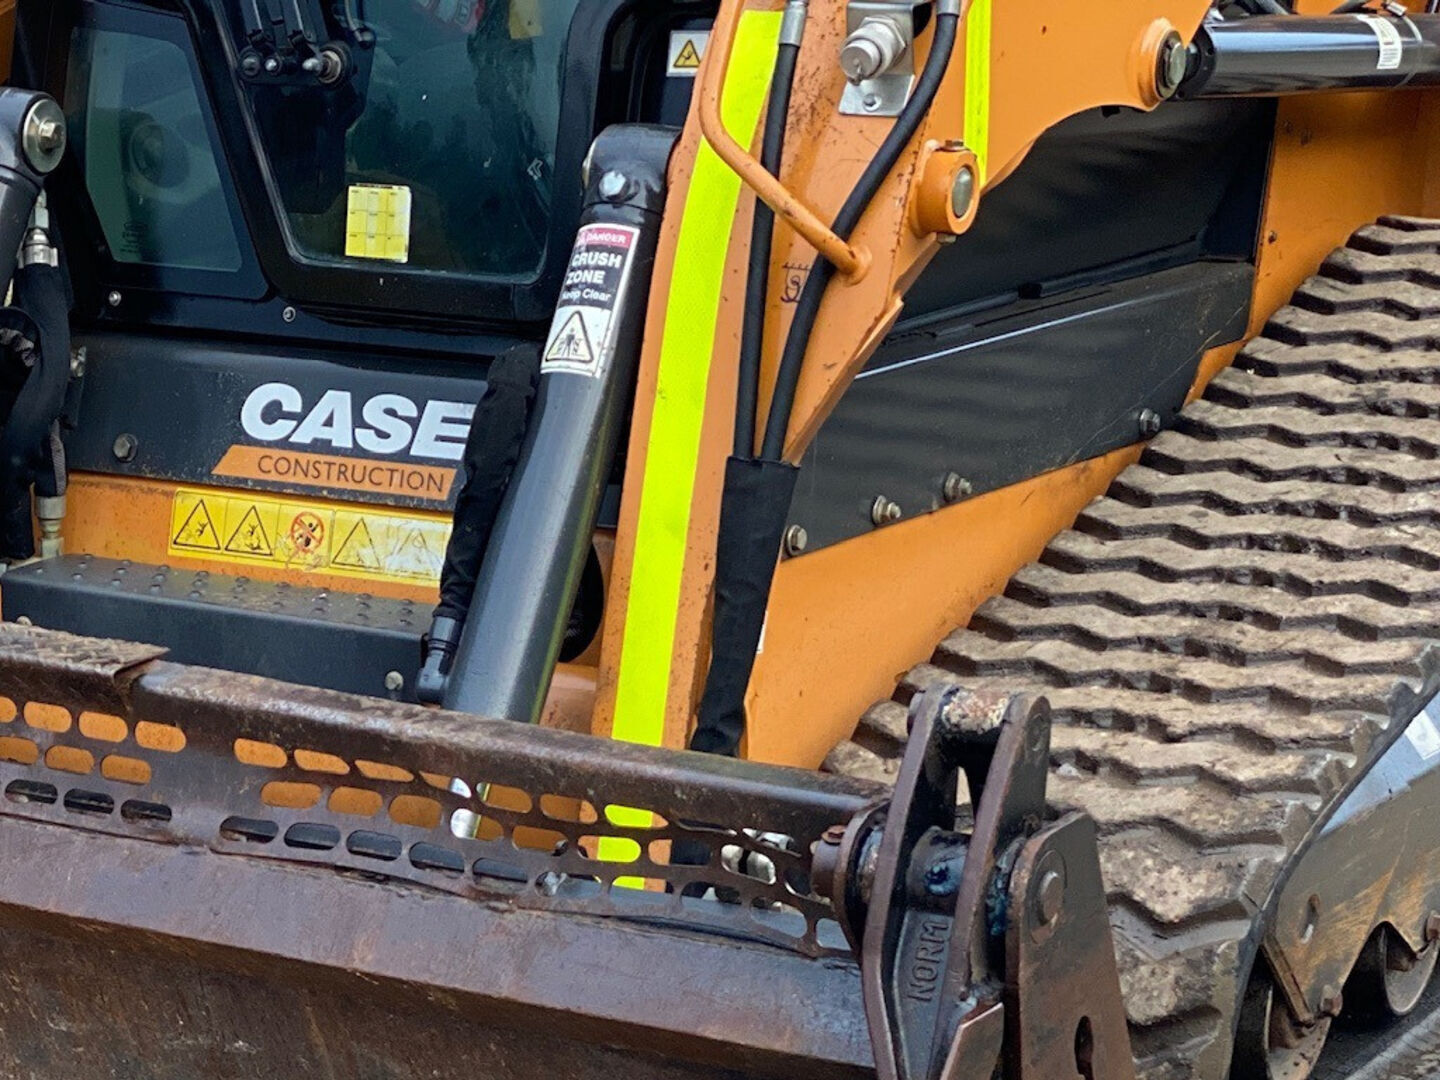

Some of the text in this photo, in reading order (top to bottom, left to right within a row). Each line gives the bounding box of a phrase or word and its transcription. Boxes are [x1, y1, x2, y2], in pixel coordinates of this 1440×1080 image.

[586, 232, 627, 244] DANGER
[572, 252, 623, 268] CRUSH
[566, 269, 606, 285] ZONE
[582, 288, 611, 303] Clear
[240, 381, 477, 461] CASE
[257, 454, 446, 493] CONSTRUCTION
[907, 921, 949, 1002] NORM
